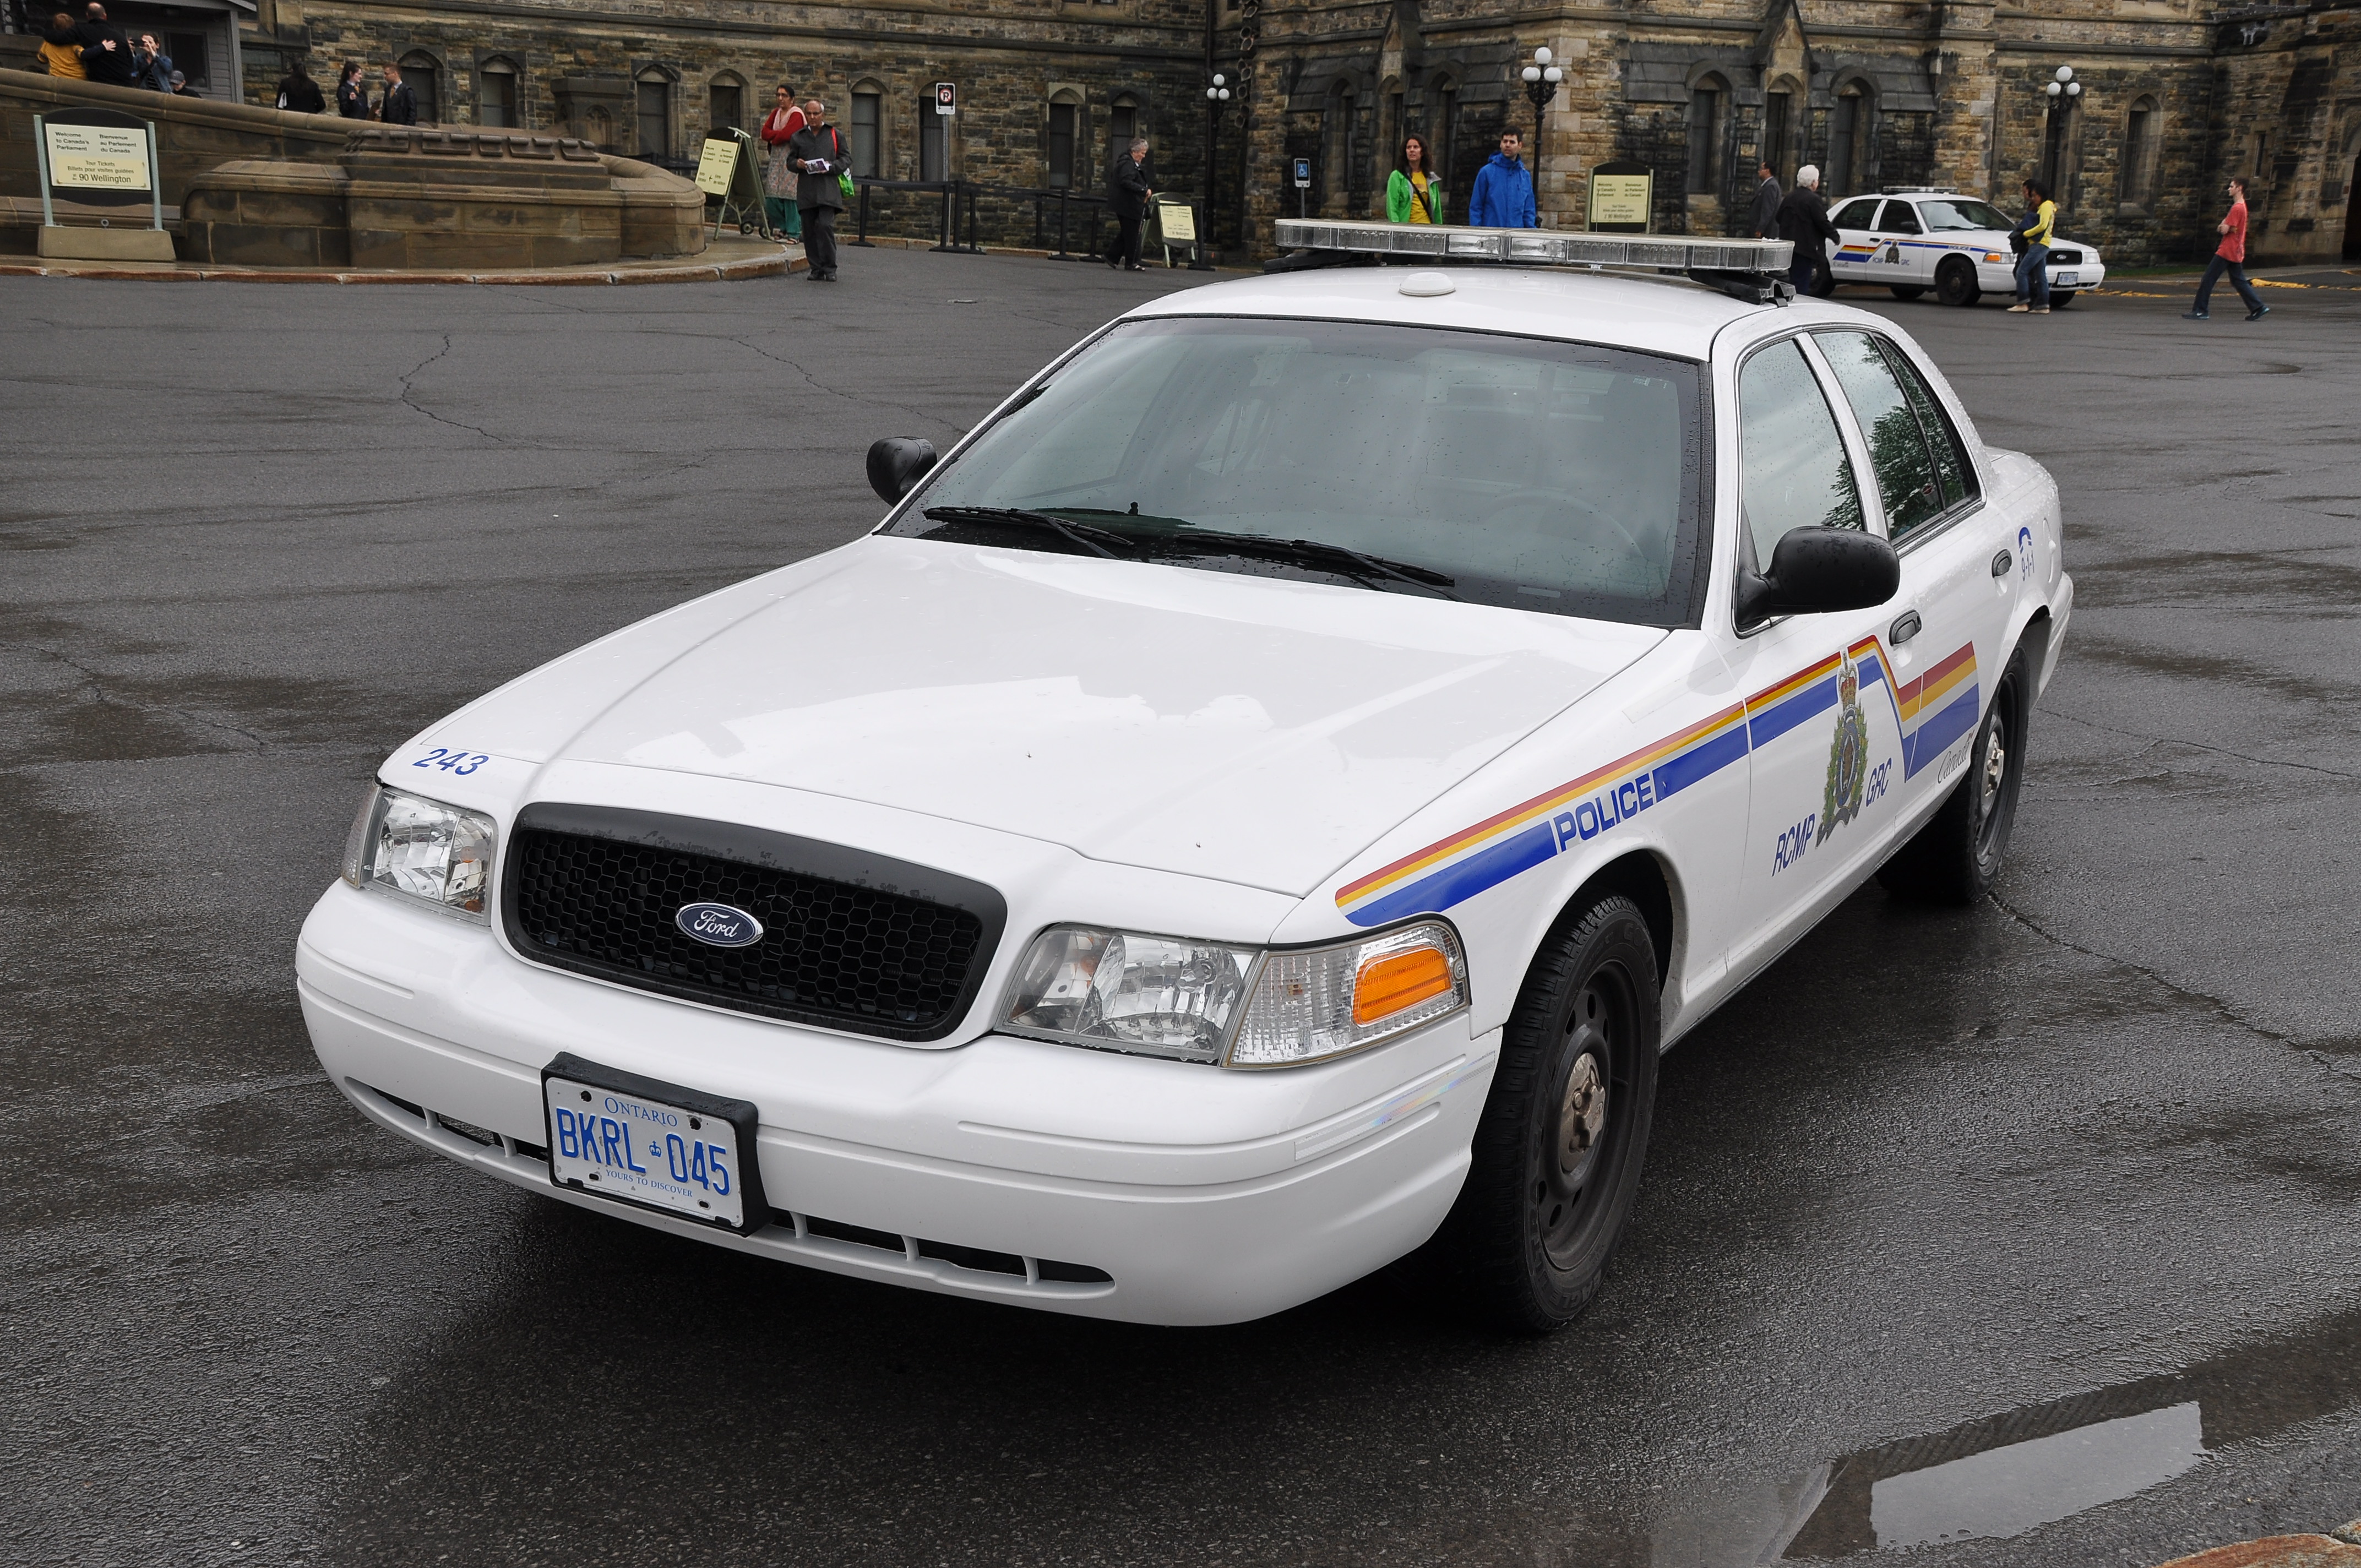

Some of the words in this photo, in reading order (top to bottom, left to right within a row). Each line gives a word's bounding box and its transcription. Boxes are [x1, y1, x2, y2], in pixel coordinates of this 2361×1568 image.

[91, 174, 131, 184] Wellington
[2021, 550, 2034, 581] 9-1-1
[412, 748, 489, 775] 243
[1866, 757, 1892, 807] GRC
[1553, 772, 1653, 852] POLICE
[1771, 813, 1816, 877] RCMP
[694, 910, 740, 938] Ford
[604, 1097, 678, 1128] ONTARIO
[556, 1108, 646, 1174] BKRL
[666, 1133, 730, 1196] 045
[606, 1169, 633, 1183] YOURS
[637, 1176, 648, 1186] TO
[650, 1180, 693, 1197] DISCOVER
